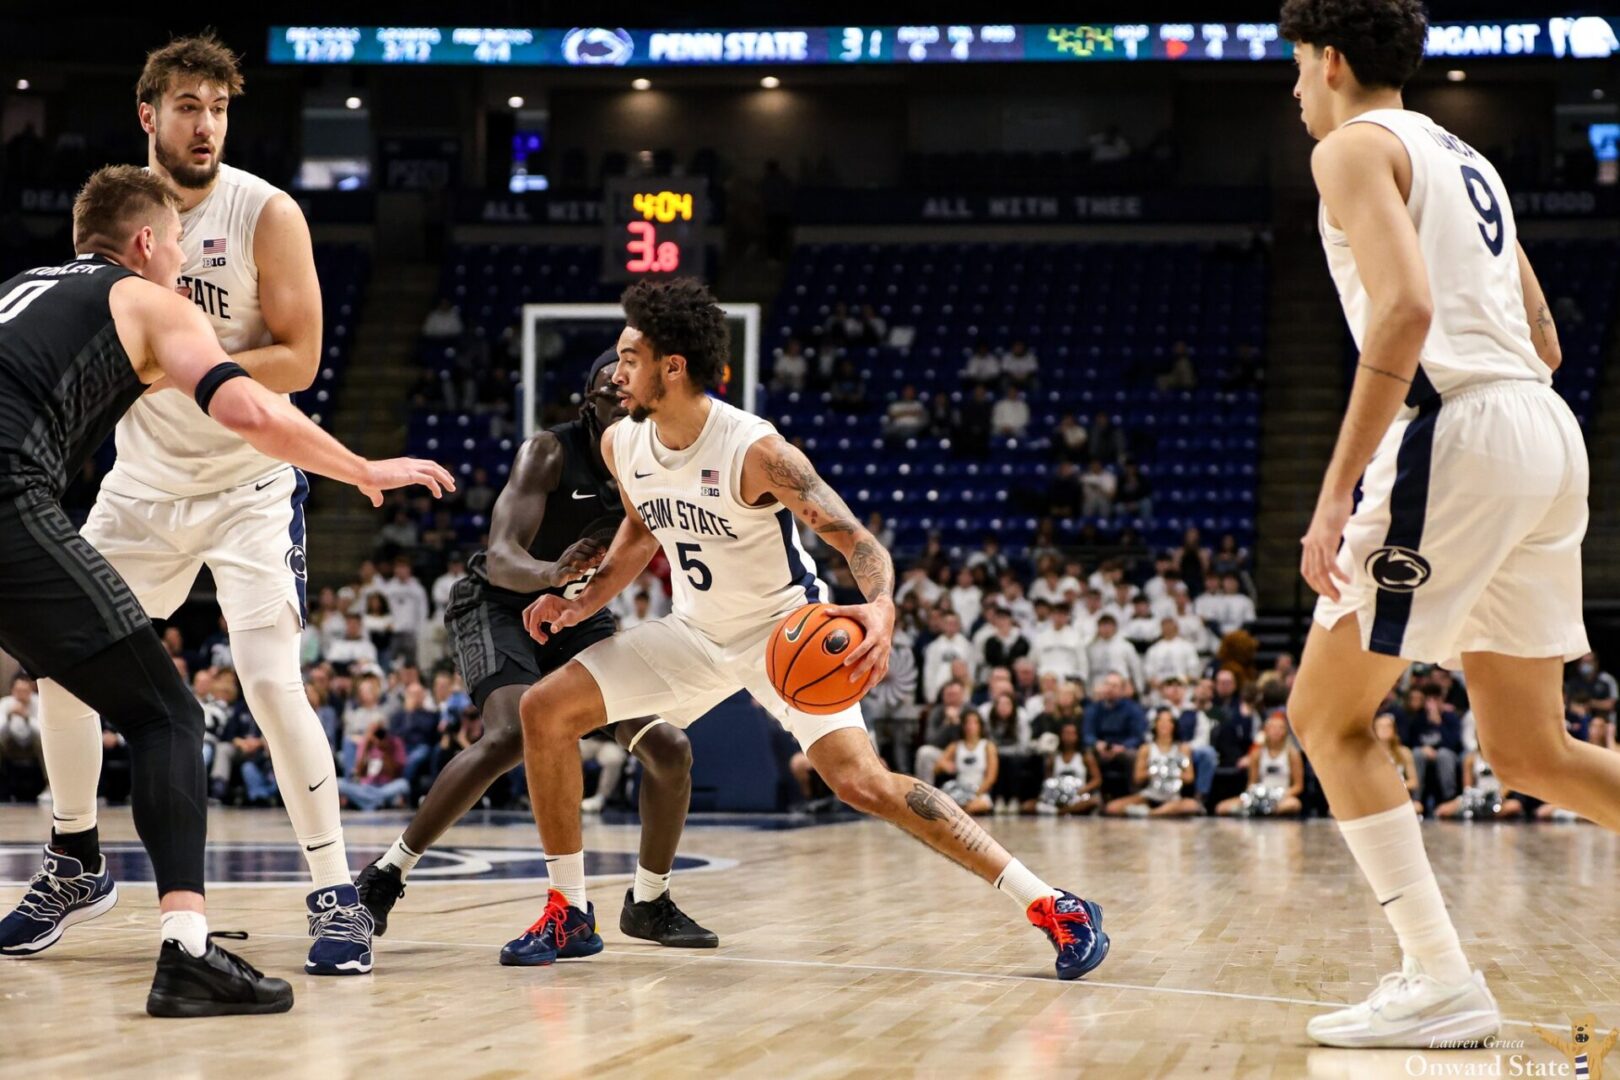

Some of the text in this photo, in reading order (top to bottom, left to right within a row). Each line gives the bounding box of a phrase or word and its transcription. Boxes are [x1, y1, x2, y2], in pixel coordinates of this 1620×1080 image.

[649, 31, 808, 61] PENN STATE
[1504, 24, 1541, 54] ST
[921, 196, 973, 218] ALL
[1460, 164, 1504, 257] 9
[0, 280, 60, 324] 0
[176, 275, 231, 319] TATE
[637, 498, 738, 540] PENN STATE
[676, 542, 713, 592] 5
